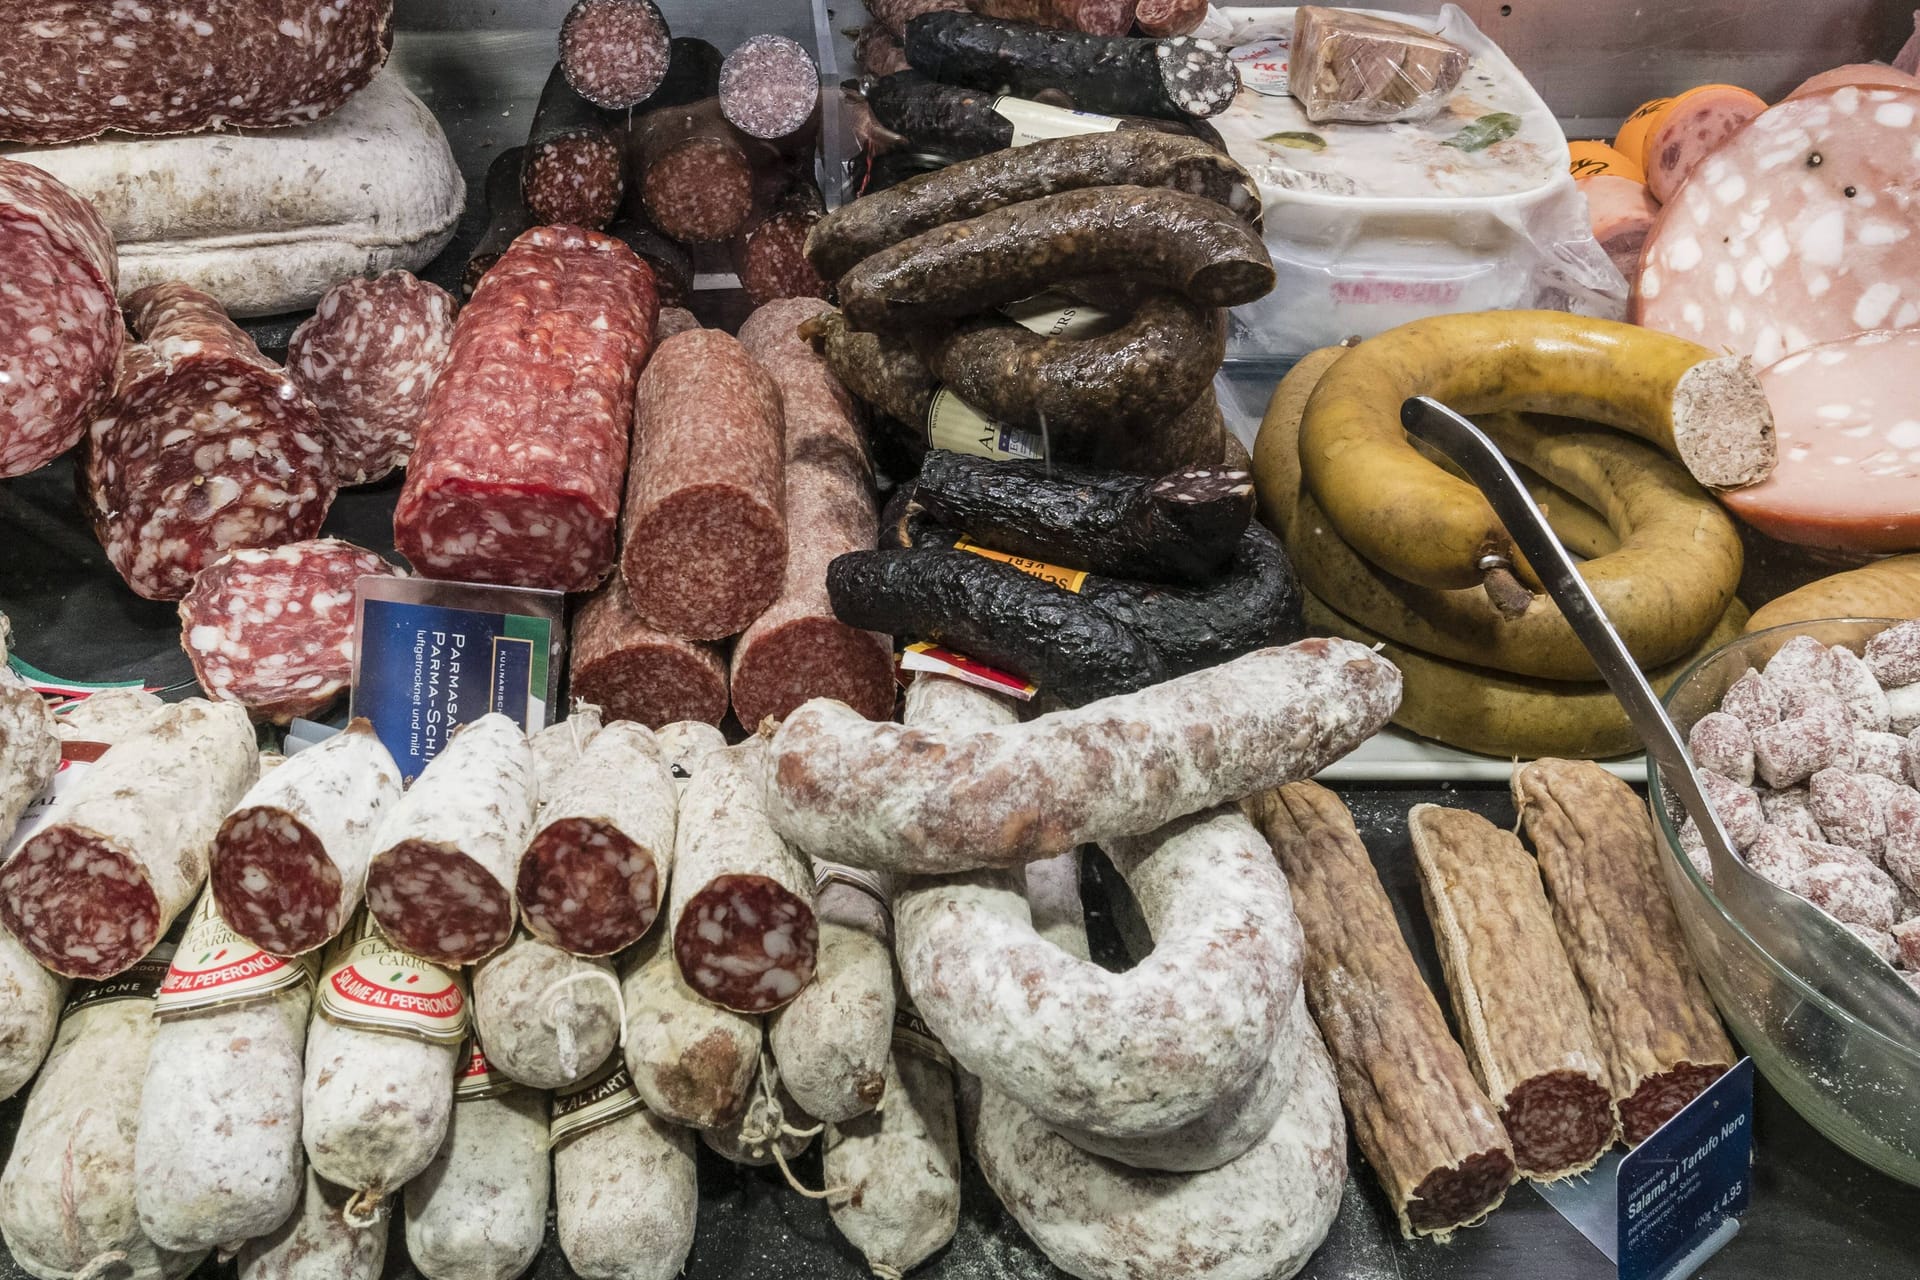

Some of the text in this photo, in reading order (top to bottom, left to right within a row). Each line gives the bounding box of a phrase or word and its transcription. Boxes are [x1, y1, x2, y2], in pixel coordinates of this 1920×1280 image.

[410, 629, 428, 756] luftgetrocknet und mild
[423, 631, 446, 763] PARMA-SCHI
[445, 633, 465, 742] PARMASAL
[175, 974, 194, 990] AL
[335, 969, 374, 1001] SALAME
[368, 989, 388, 1005] AL
[1627, 1113, 1745, 1219] Salame al Tartufo Nero
[1721, 1181, 1743, 1206] 4.95
